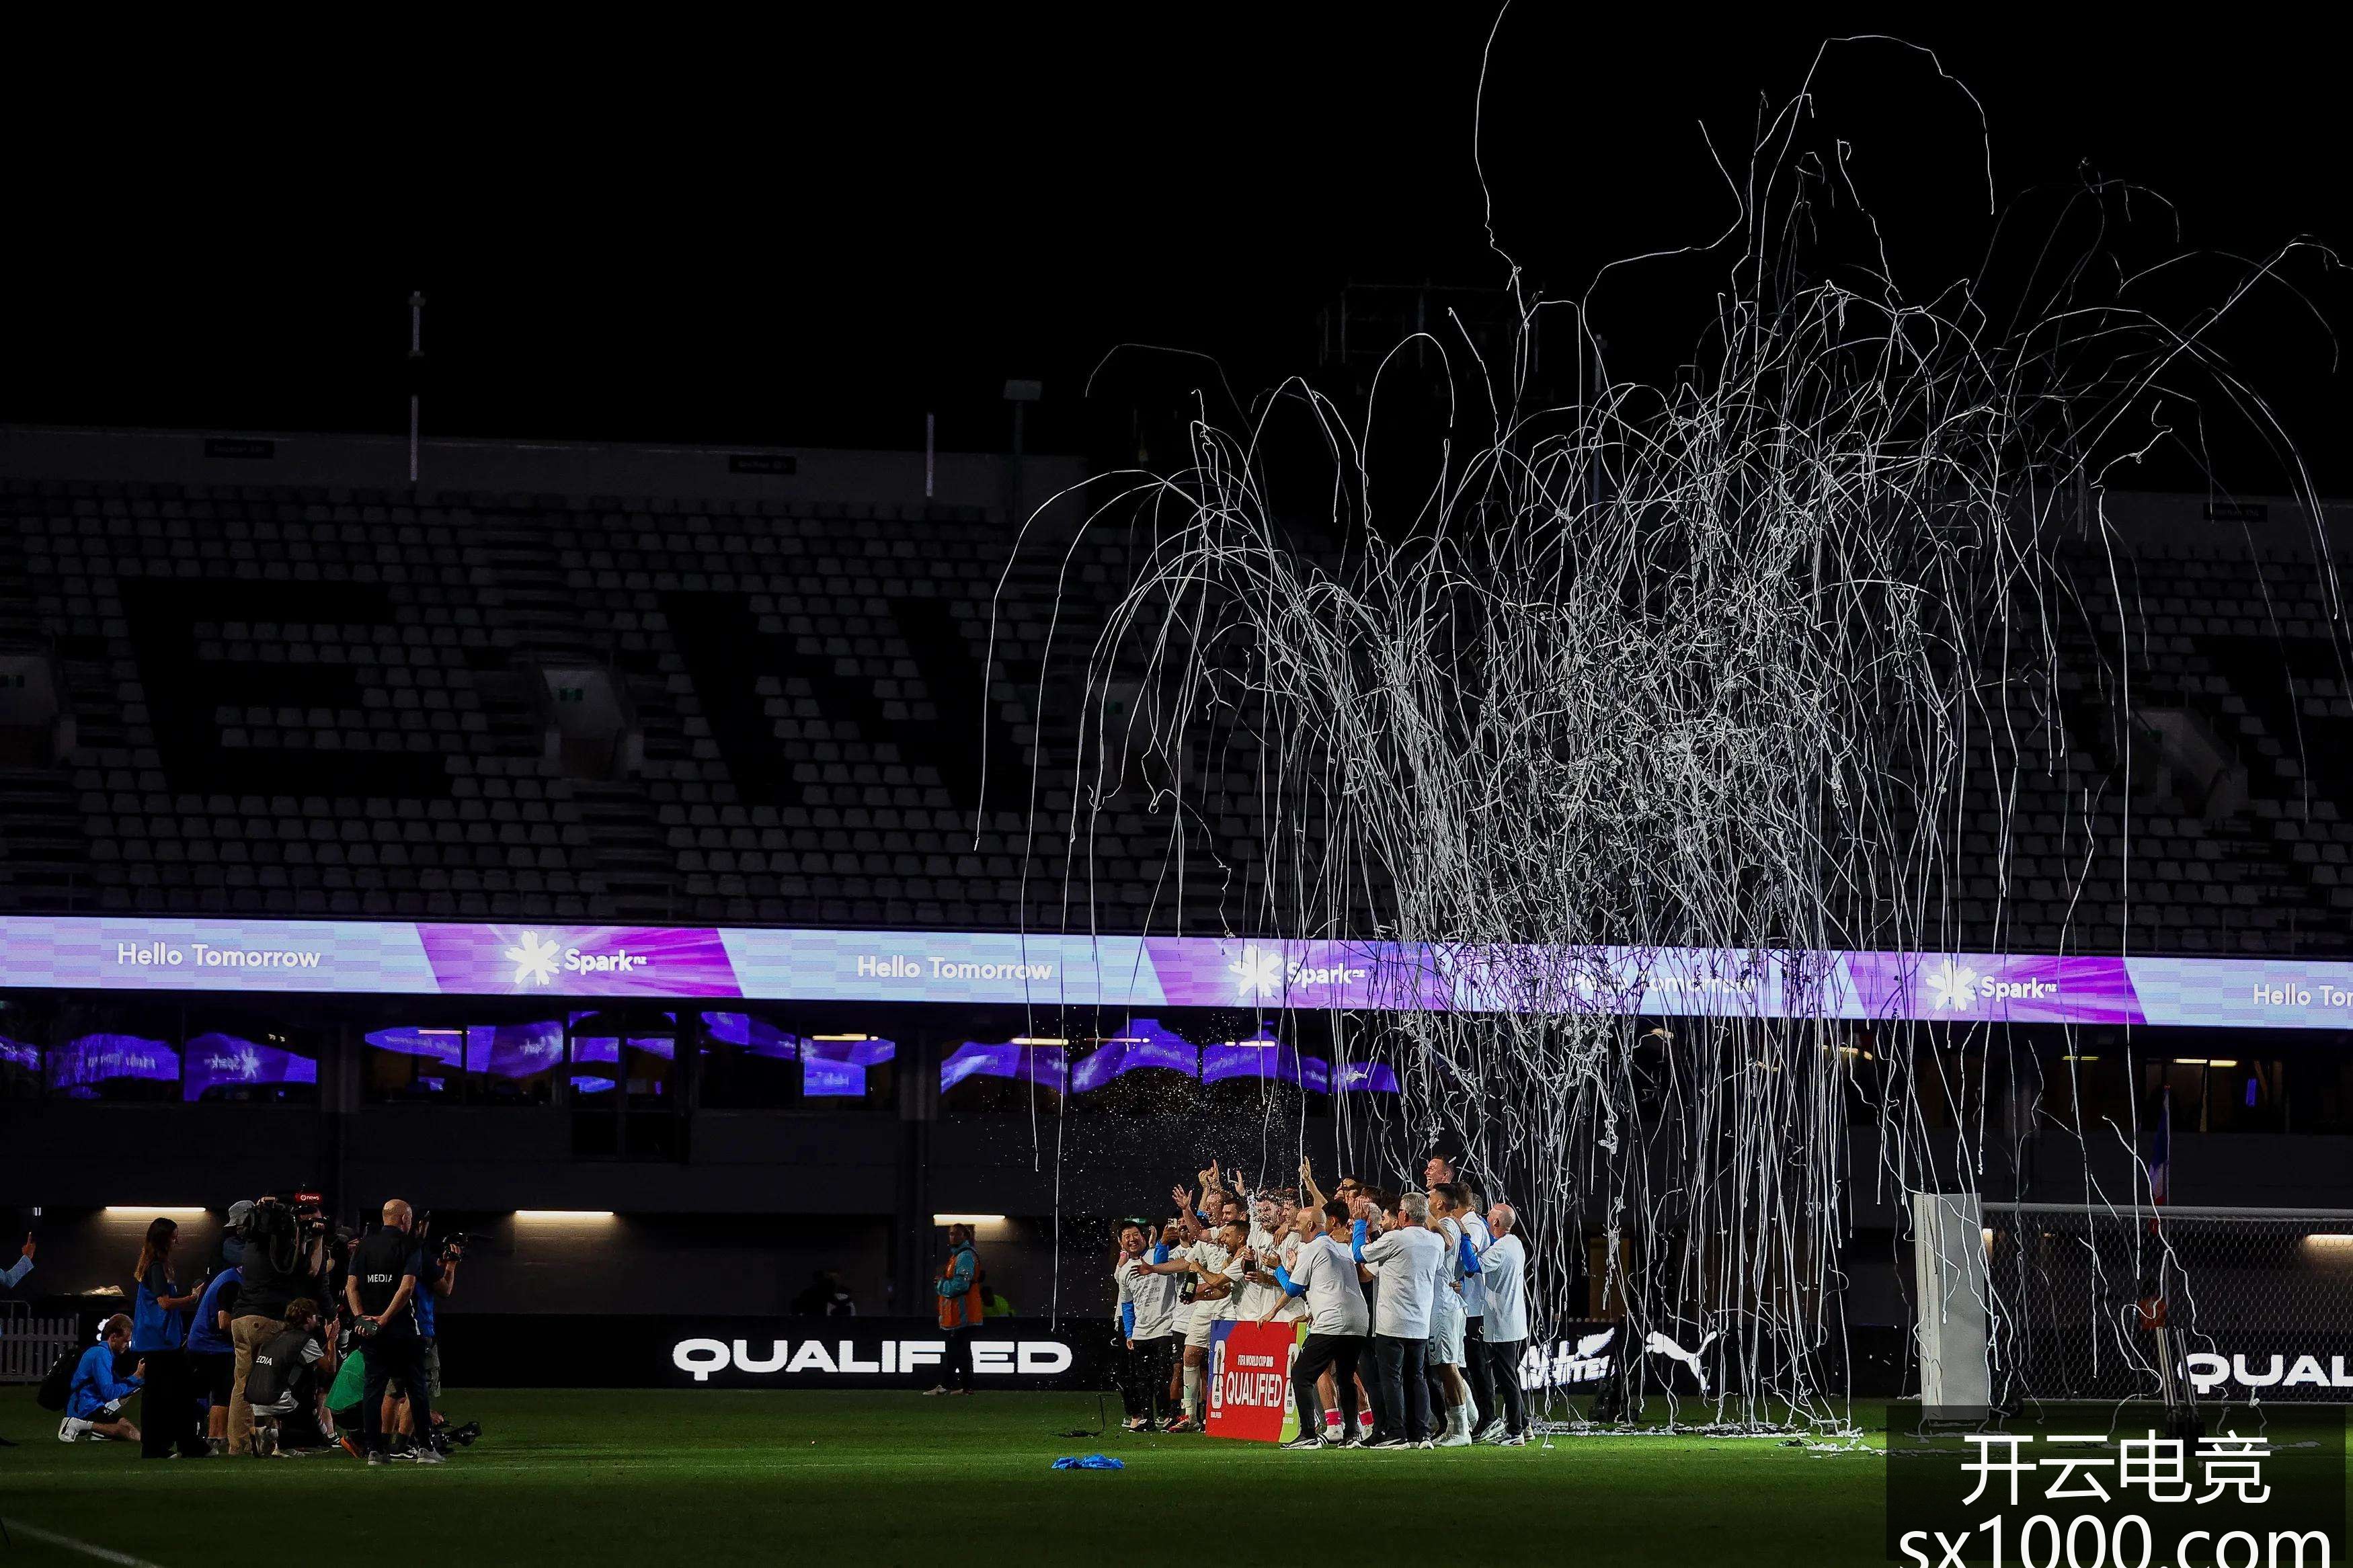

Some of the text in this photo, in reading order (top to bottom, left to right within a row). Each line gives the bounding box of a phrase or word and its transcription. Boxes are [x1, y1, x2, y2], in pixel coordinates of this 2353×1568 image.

[118, 942, 321, 968] Hello Tomorrow
[564, 948, 633, 973] Spark
[858, 955, 1052, 980] Hello Tomorrow
[1287, 962, 1352, 988] Spark
[1981, 976, 2044, 1002] Spark
[2254, 983, 2311, 1005] Hello
[367, 1274, 393, 1283] MEDIA
[255, 1355, 272, 1366] EDIA
[673, 1338, 1072, 1381] QUALIFED
[1226, 1371, 1283, 1407] QUALIFIED
